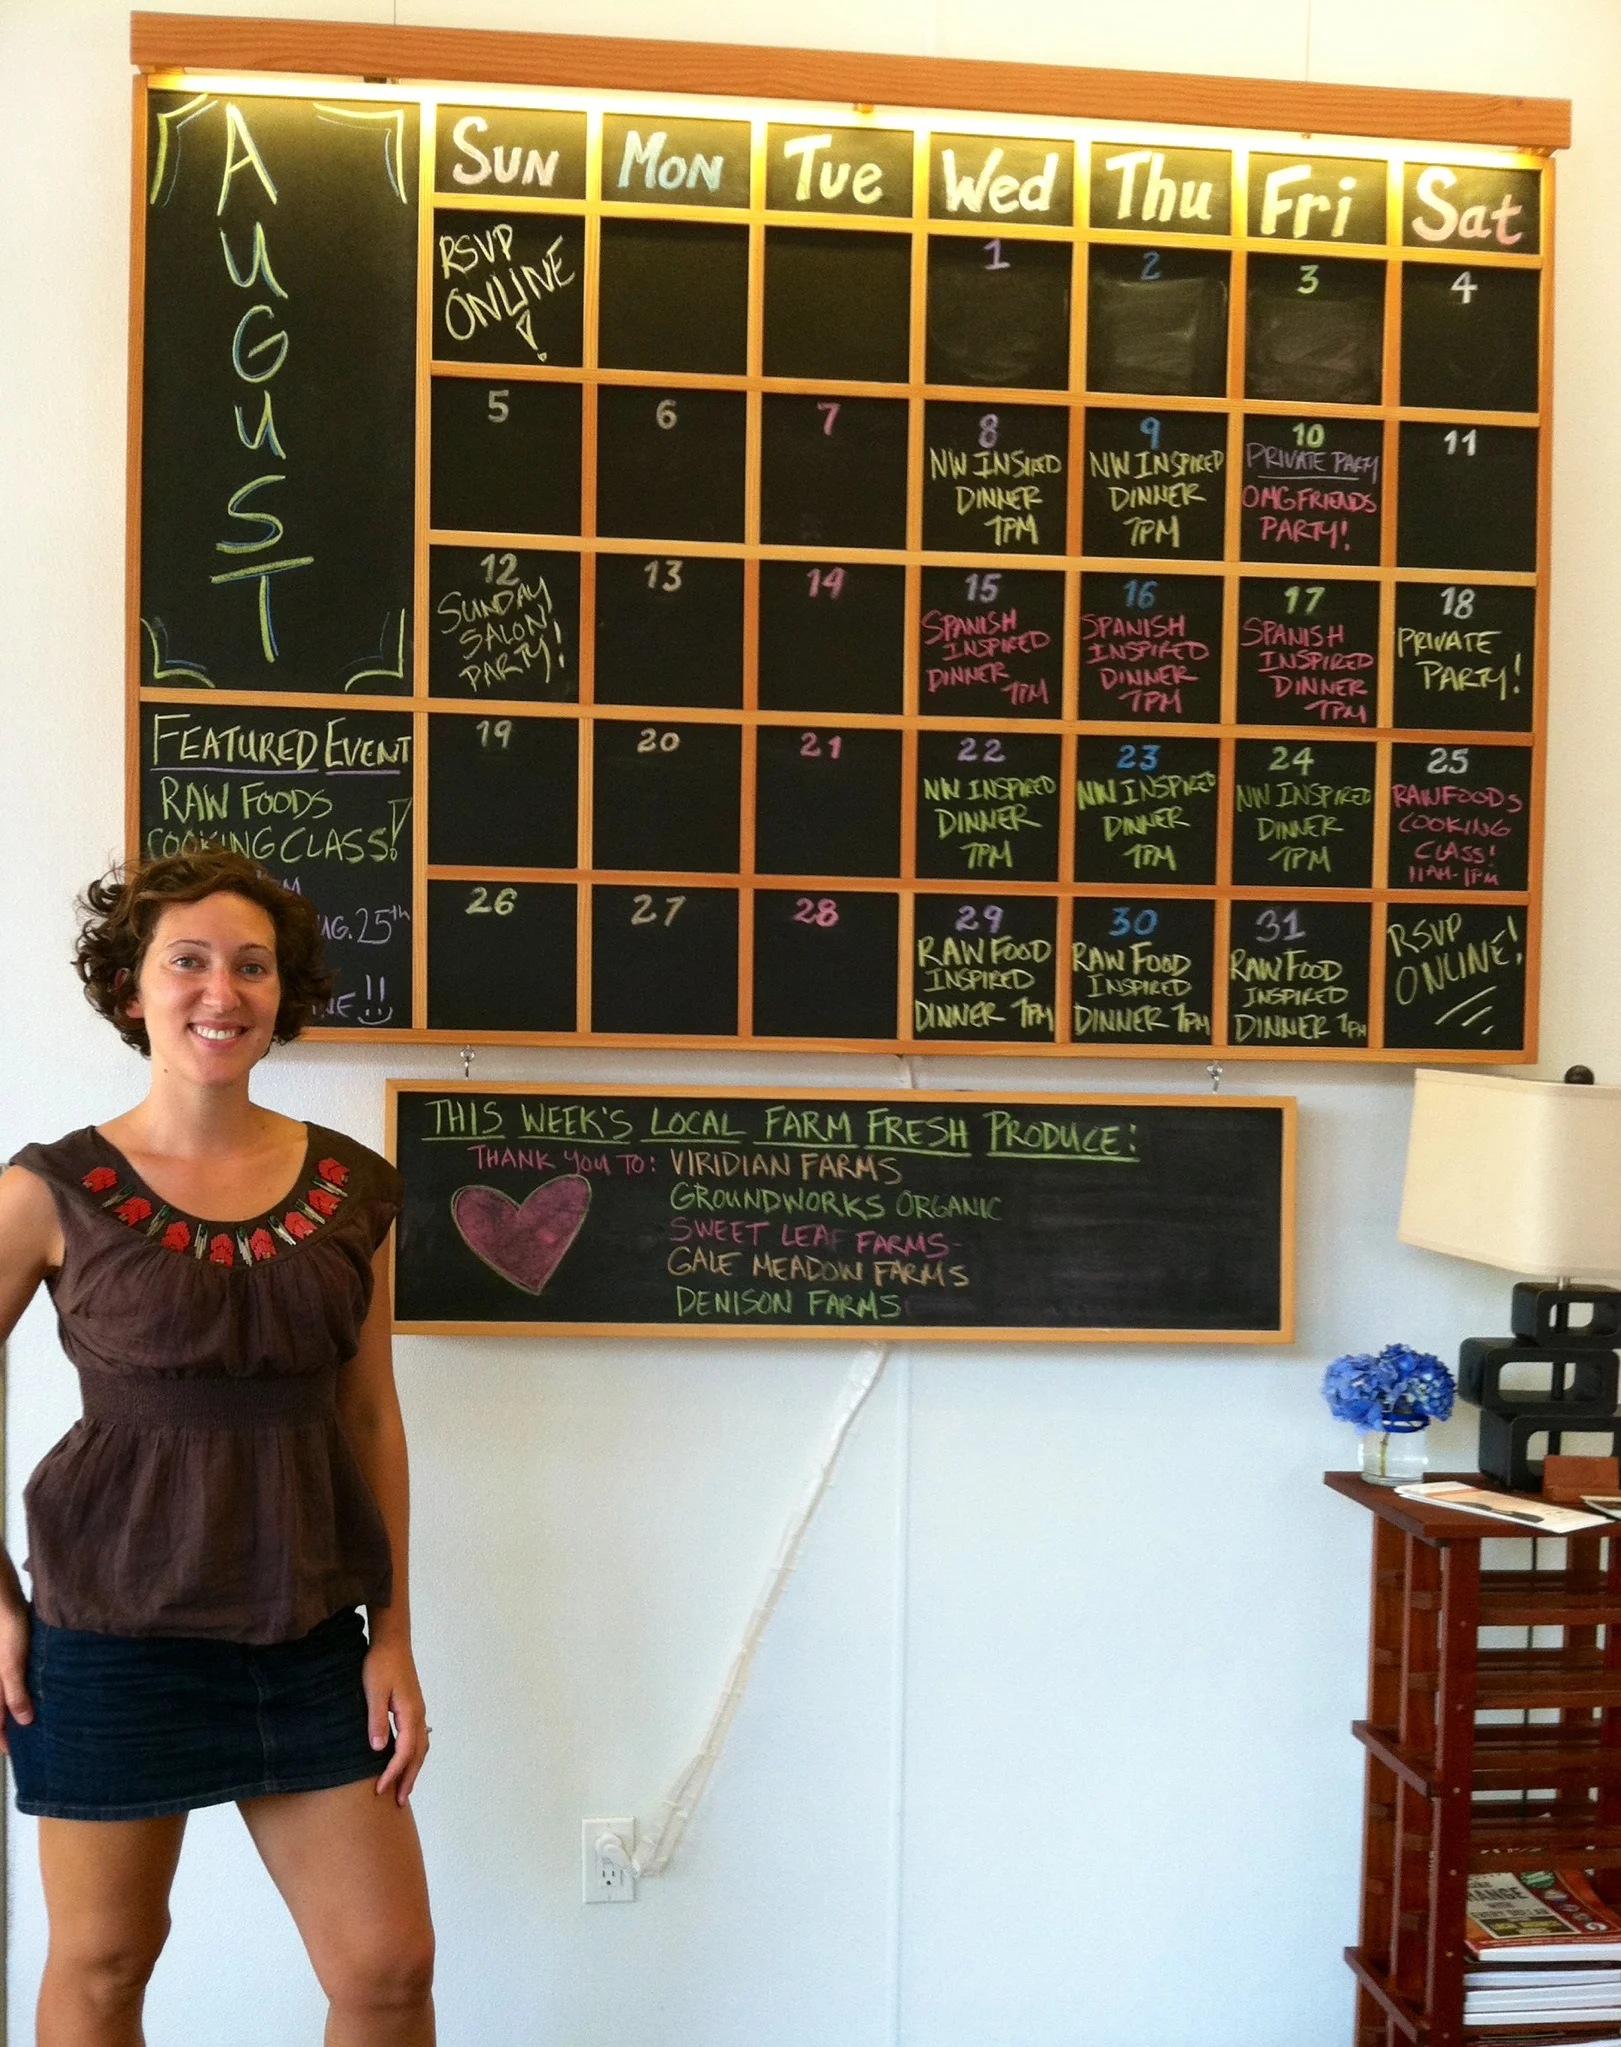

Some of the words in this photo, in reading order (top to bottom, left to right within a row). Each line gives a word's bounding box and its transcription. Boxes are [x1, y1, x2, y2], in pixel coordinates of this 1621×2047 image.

[942, 148, 1059, 214] Wed
[1106, 150, 1213, 222] Thu
[1261, 165, 1357, 238] Fri
[1412, 166, 1523, 245] Sat
[439, 224, 513, 279] RSVP
[983, 238, 1010, 271] 1
[1141, 252, 1161, 280] 2
[1297, 265, 1319, 294] 3
[1451, 271, 1477, 304] 4
[488, 389, 509, 423] 5
[656, 400, 677, 429] 6
[817, 402, 840, 435] 7
[979, 414, 998, 448] 8
[1140, 416, 1161, 449] 9
[1293, 424, 1325, 448] 10
[1444, 430, 1478, 456] 11
[929, 448, 966, 480] NW
[1090, 451, 1129, 479] NW
[1246, 443, 1327, 472] PRIVATE
[1331, 451, 1379, 485] PARTY
[956, 485, 1043, 515] DINNER
[1108, 483, 1206, 512] DINNER
[984, 514, 1039, 546] 7PM
[1123, 515, 1180, 547] 7PM
[1259, 517, 1351, 551] PARTY!
[480, 553, 521, 586] 12
[644, 560, 683, 592] 13
[807, 567, 846, 599] 14
[965, 573, 1002, 603] 15
[1124, 580, 1158, 609] 16
[1284, 586, 1325, 615] 17
[1441, 587, 1476, 619] 18
[437, 576, 553, 634] SUNDAY
[459, 604, 548, 660] SALON
[921, 608, 1017, 644] SPANISH
[1082, 614, 1185, 639] SPANISH
[1240, 618, 1344, 647] SPANISH
[459, 621, 565, 691] PARTY!
[942, 631, 1050, 661] INSPIRED
[1086, 641, 1209, 664] INSPIRED
[1398, 627, 1500, 658] PRIVATE
[1258, 650, 1374, 673] INSPIRED
[1415, 653, 1521, 701] PARTY!
[927, 663, 1010, 692] DINNER
[1100, 666, 1199, 690] DINNER
[1270, 676, 1368, 698] DINNER
[152, 714, 319, 768] FEATURED
[325, 717, 412, 768] EVENT
[476, 720, 512, 749] 19
[637, 728, 680, 753] 20
[800, 732, 842, 759] 21
[957, 738, 1005, 763] 22
[1116, 744, 1160, 771] 23
[1268, 746, 1314, 776] 24
[1426, 747, 1469, 774] 25
[160, 776, 229, 824] RAW
[241, 781, 333, 820] FOODS
[924, 777, 959, 801] NW
[967, 776, 1056, 801] INSPIRED
[1077, 779, 1115, 811] NW
[1120, 771, 1216, 805] INSPIRED
[1236, 783, 1270, 812] NW
[1276, 781, 1371, 808] INSPIRED
[935, 804, 1043, 839] DINNER
[1103, 806, 1190, 842] DINNER
[1258, 815, 1344, 841] DINNER
[1398, 813, 1512, 838] COOKING
[960, 840, 1013, 869] 7PM
[1123, 844, 1177, 871] 7PM
[1268, 847, 1331, 873] 7PM
[1414, 841, 1497, 867] CLASS!
[465, 887, 518, 915] 26
[630, 893, 687, 926] 27
[793, 898, 840, 928] 28
[955, 905, 1003, 933] 29
[1108, 907, 1158, 936] 30
[1256, 909, 1306, 942] 31
[1387, 912, 1462, 957] RSVP
[917, 936, 982, 967] RAW
[990, 935, 1052, 964] FOOD
[1072, 942, 1124, 973] RAW
[1129, 941, 1192, 975] FOOD
[1230, 949, 1281, 982] RAW
[1283, 950, 1343, 981] FOOD
[1395, 915, 1524, 1006] ONLINE!
[923, 968, 1035, 992] INSPIRED
[1087, 973, 1192, 998] INSPIRED
[1242, 987, 1348, 1008] INSPIRED
[914, 1000, 1006, 1033] DINNER
[1011, 996, 1055, 1032] 7PM
[1072, 1002, 1170, 1036] DINNER
[1171, 1003, 1211, 1036] 7PM
[1234, 1014, 1330, 1042] DINNER
[425, 1099, 504, 1137] THIS
[521, 1102, 634, 1141] WEEK'S
[651, 1106, 748, 1138] LOCAL
[765, 1105, 853, 1143] FARM
[867, 1107, 969, 1149] FRESH
[982, 1110, 1138, 1155] PRODUCE:
[467, 1144, 556, 1171] THANK
[616, 1153, 657, 1175] TO:
[669, 1148, 792, 1178] VIRIDIAN
[800, 1152, 903, 1185] FARMS
[670, 1181, 885, 1221] GROUNDWORKS
[896, 1190, 1003, 1221] ORGANIC
[670, 1216, 770, 1244] SWEET
[667, 1246, 742, 1277] GALE
[753, 1251, 863, 1283] MEADOW
[875, 1260, 970, 1288] FARMS
[676, 1285, 793, 1318] DENISON
[808, 1289, 900, 1319] FARMS
